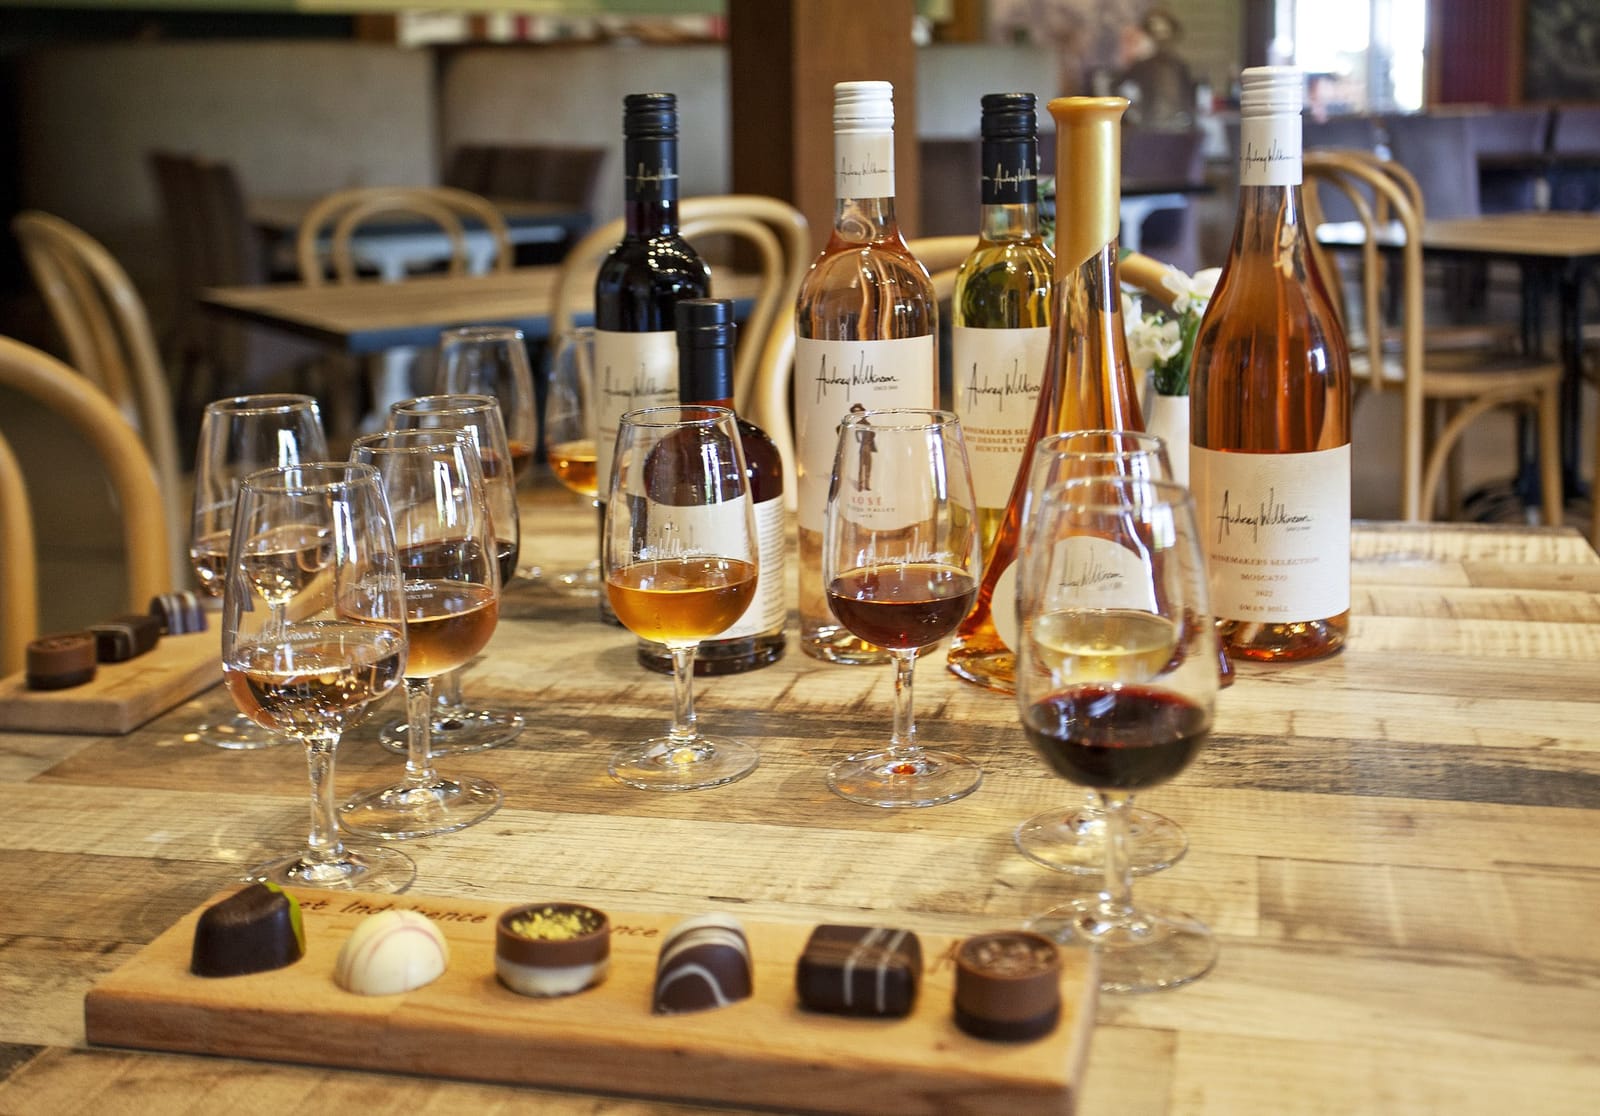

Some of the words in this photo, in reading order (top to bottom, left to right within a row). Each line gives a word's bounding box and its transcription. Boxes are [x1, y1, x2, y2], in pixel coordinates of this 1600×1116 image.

[816, 353, 851, 404] Audrey
[852, 349, 901, 387] Wilkinson
[966, 362, 1004, 413] Audrey
[1216, 489, 1260, 545] Audrey
[1260, 486, 1314, 527] Wilkinson
[1240, 573, 1289, 582] MOSCATO
